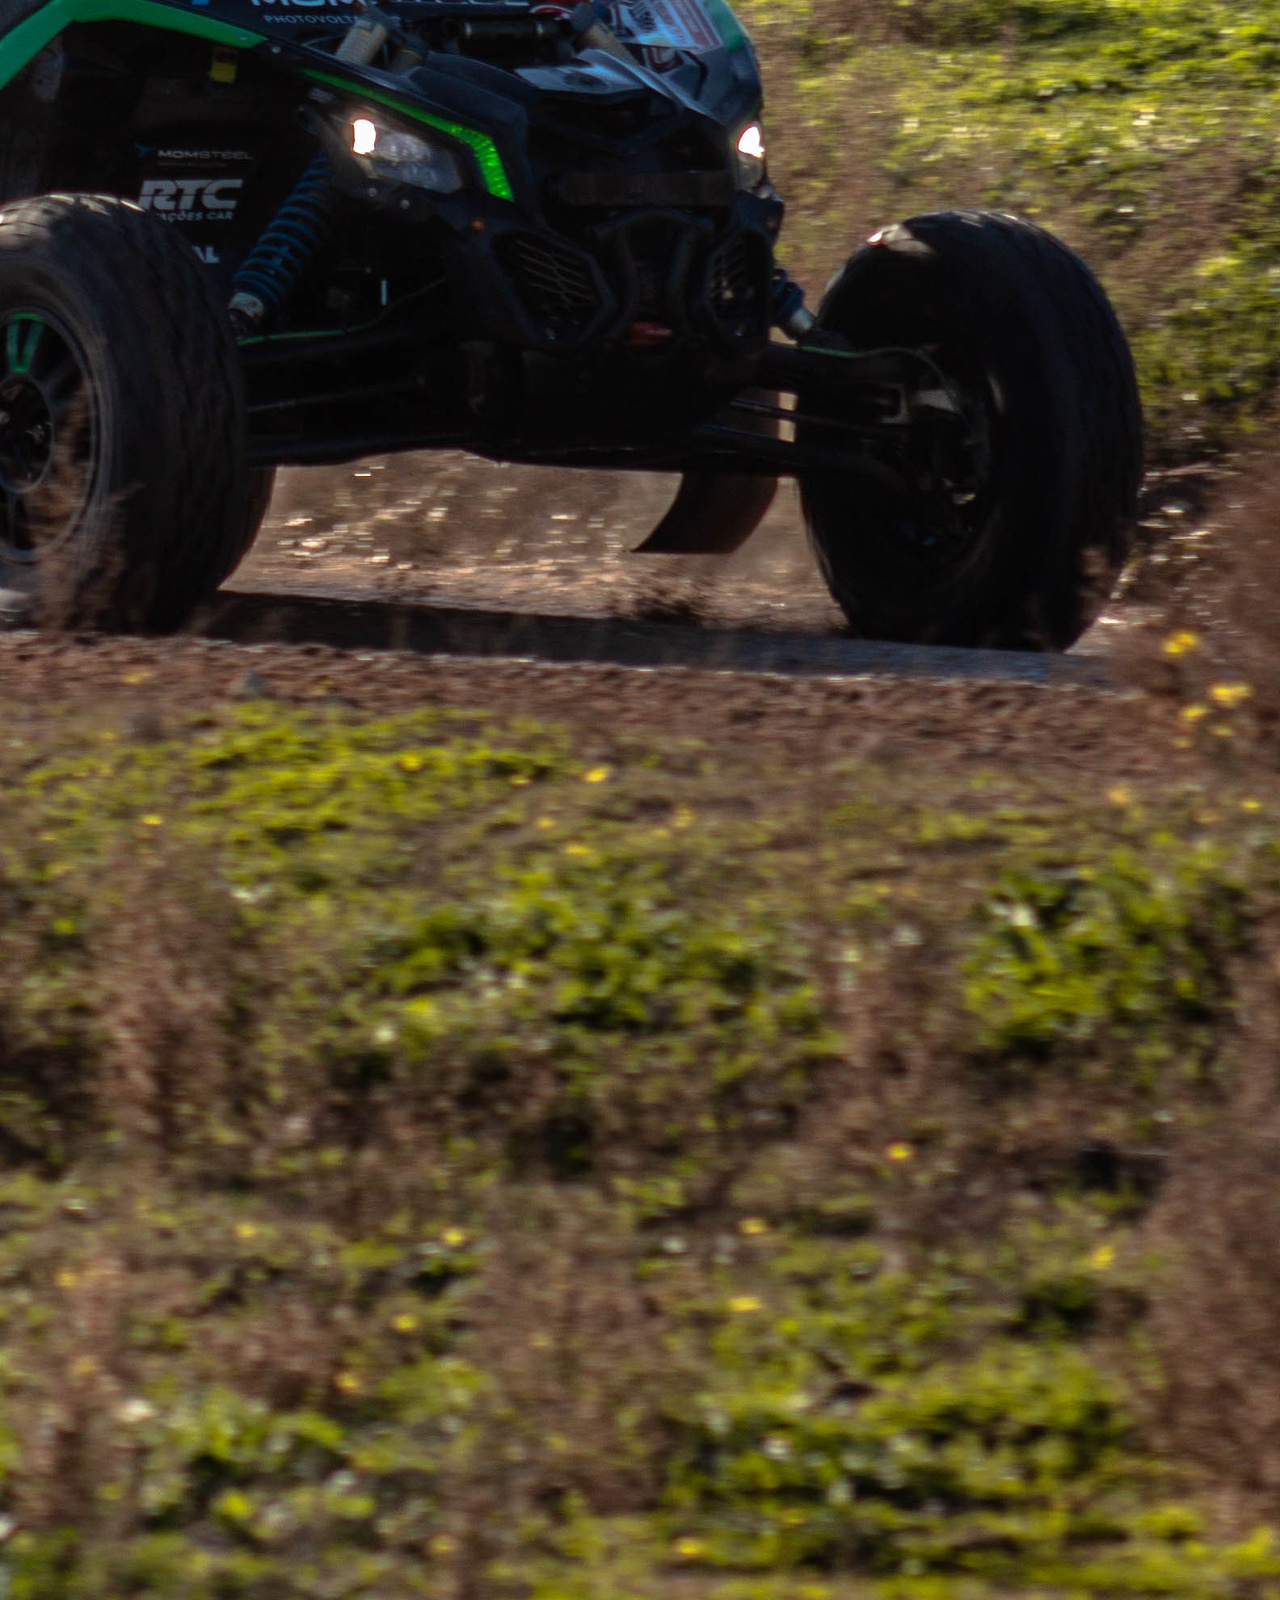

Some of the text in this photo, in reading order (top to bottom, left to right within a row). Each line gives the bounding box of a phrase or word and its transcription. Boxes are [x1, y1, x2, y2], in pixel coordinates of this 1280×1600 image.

[157, 150, 254, 160] MOMSTEEL
[138, 179, 243, 210] RTC
[206, 211, 234, 221] CAR
